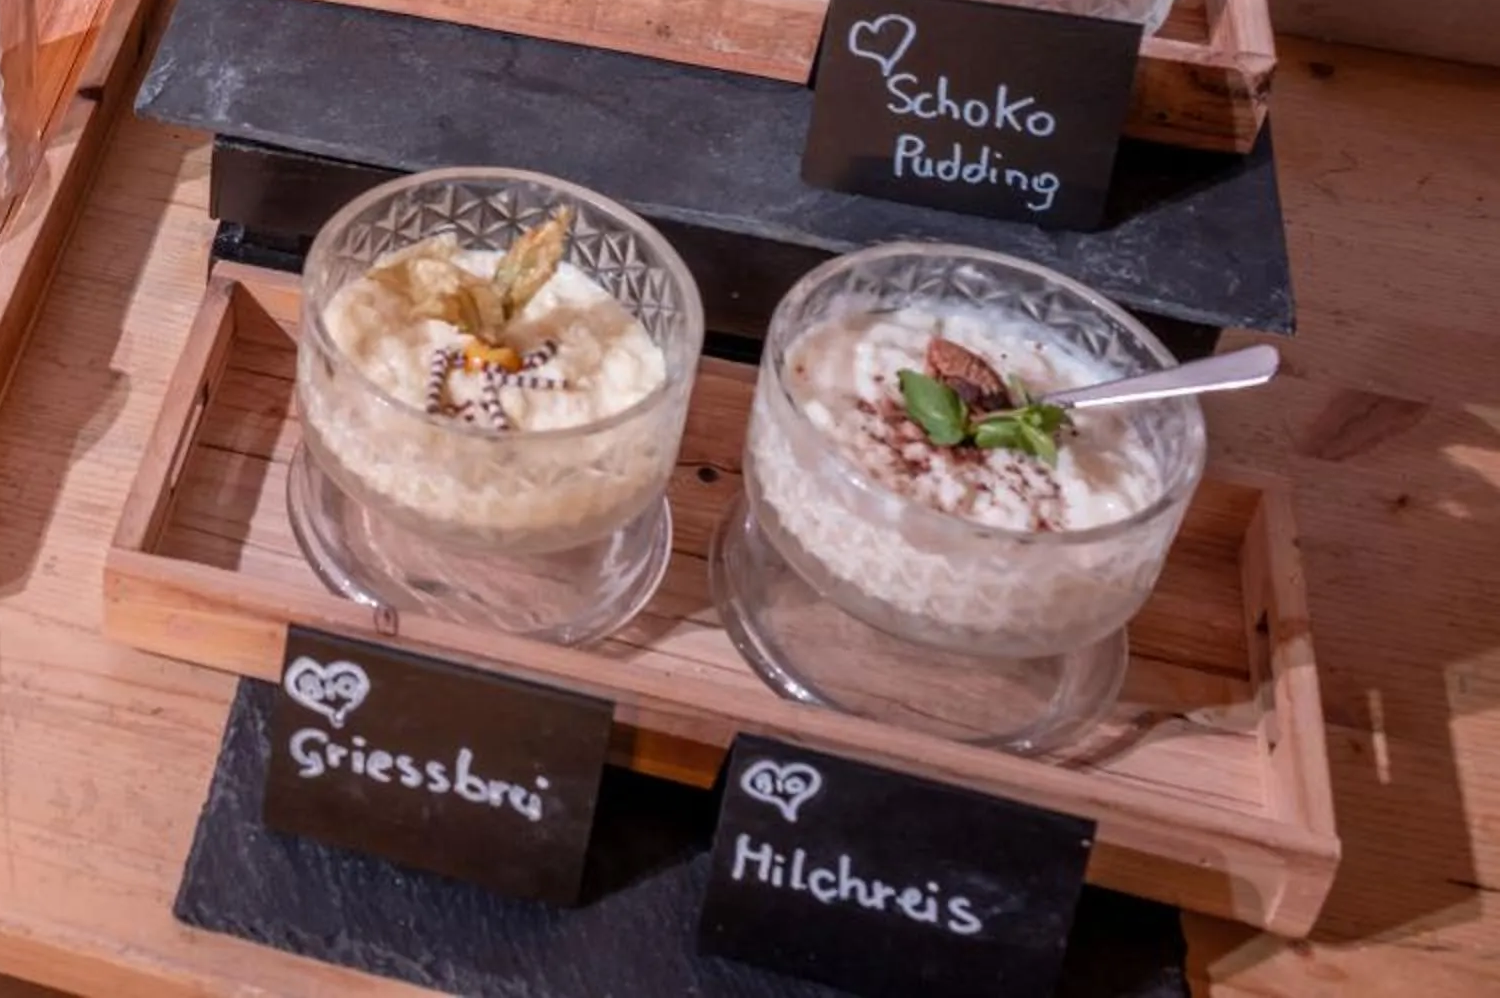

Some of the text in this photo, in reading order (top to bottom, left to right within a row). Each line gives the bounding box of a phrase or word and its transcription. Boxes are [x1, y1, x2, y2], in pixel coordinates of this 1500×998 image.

[893, 133, 1061, 211] Pudding
[289, 728, 551, 822] Griessbrei
[731, 832, 984, 935] Milchreis
